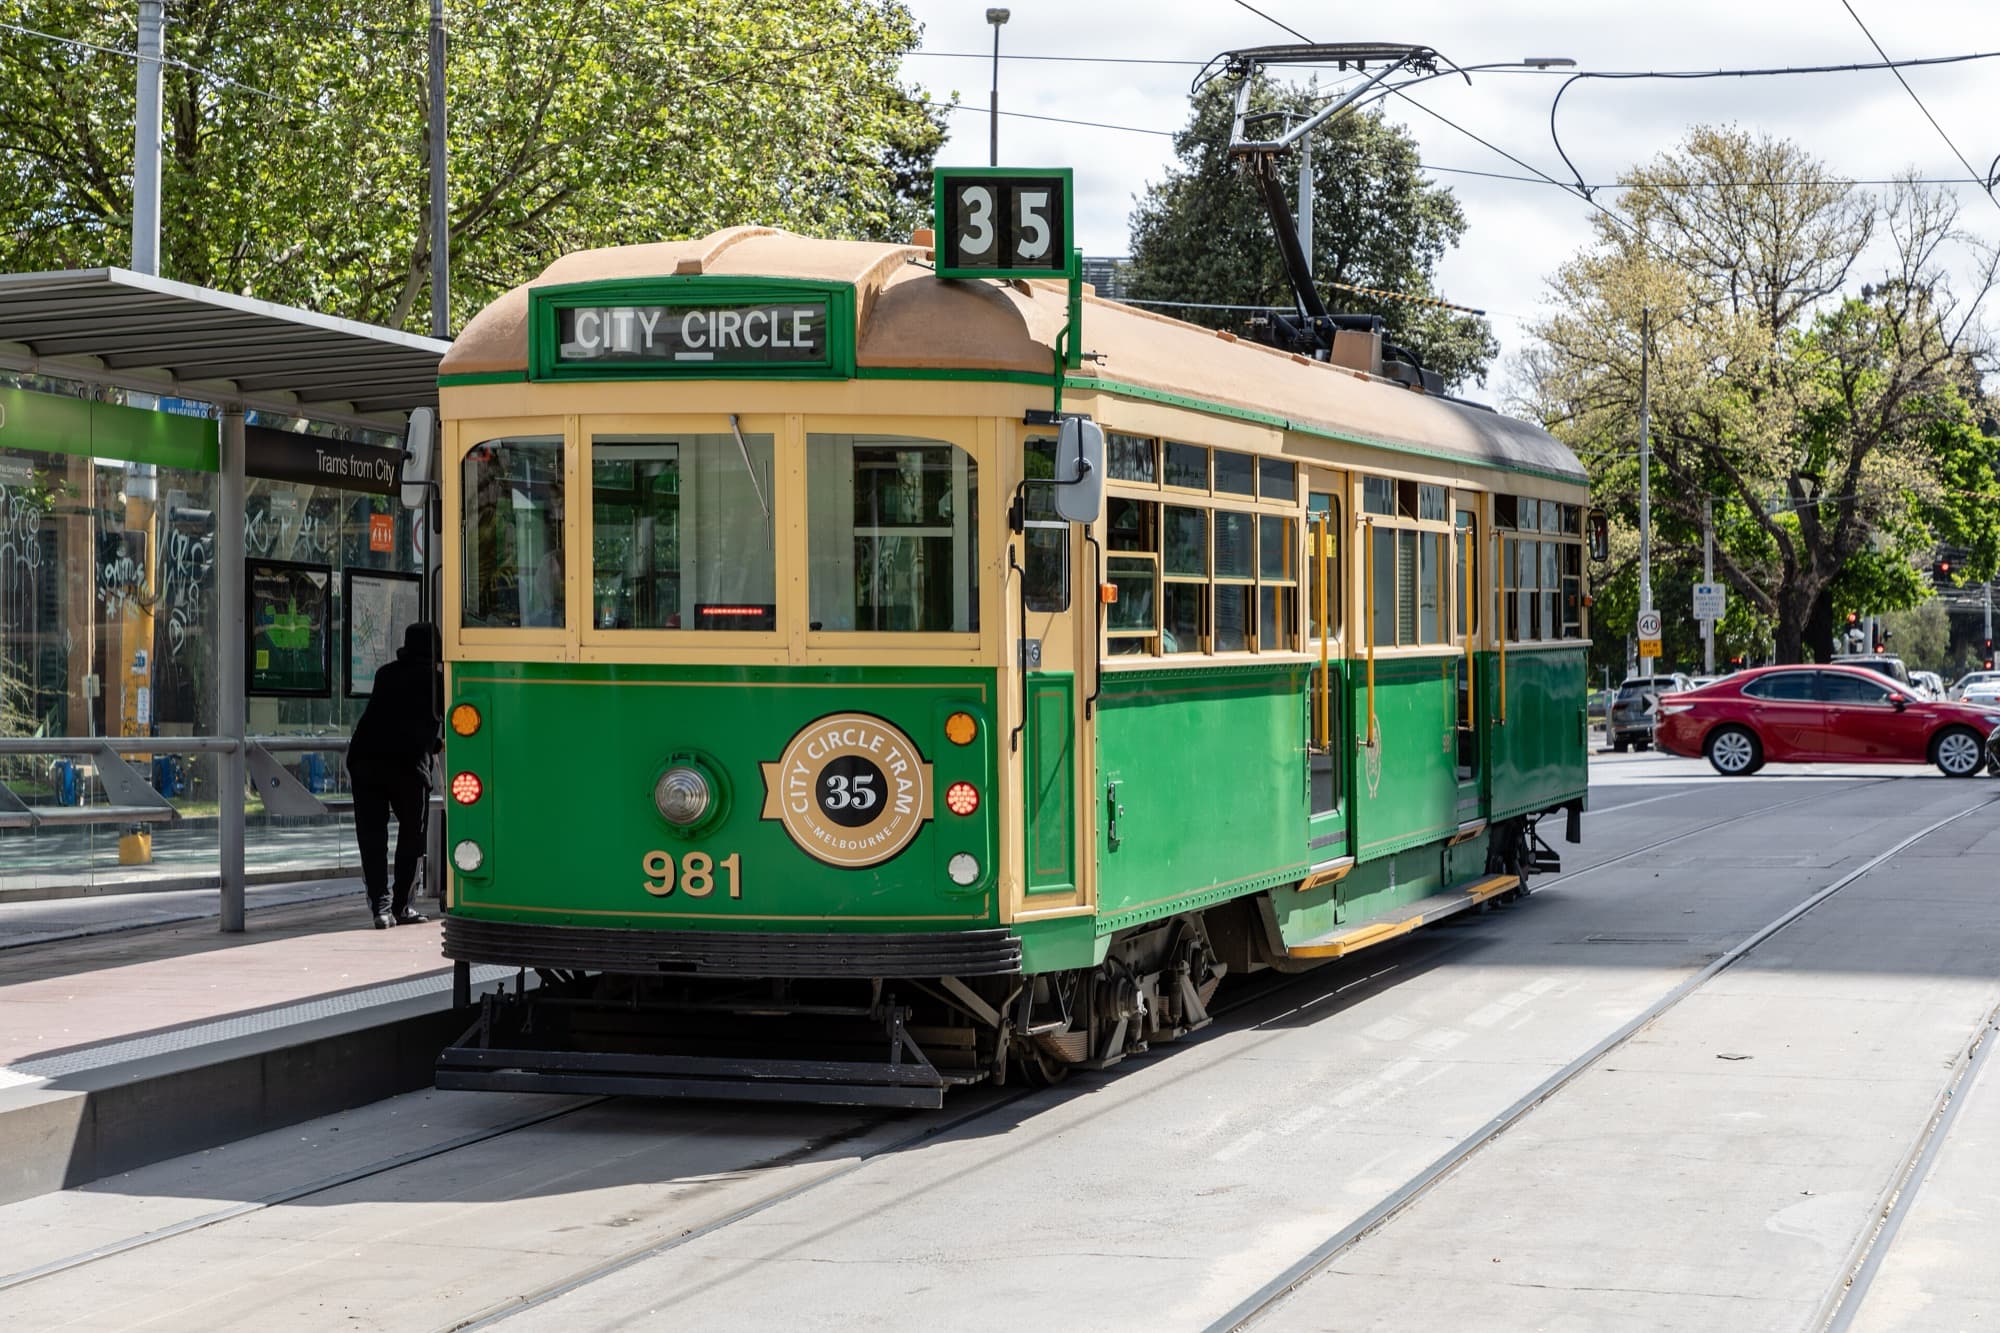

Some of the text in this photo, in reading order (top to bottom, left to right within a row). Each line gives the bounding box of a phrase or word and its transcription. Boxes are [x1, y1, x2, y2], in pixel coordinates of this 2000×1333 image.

[575, 310, 815, 348] CITY CIRCLE
[316, 449, 395, 487] Trams from City
[1642, 619, 1658, 631] 40
[790, 728, 914, 815] CITY CIRCLE TRAM
[825, 773, 877, 810] 35
[813, 826, 892, 850] MELBOURNE
[642, 850, 742, 899] 981
